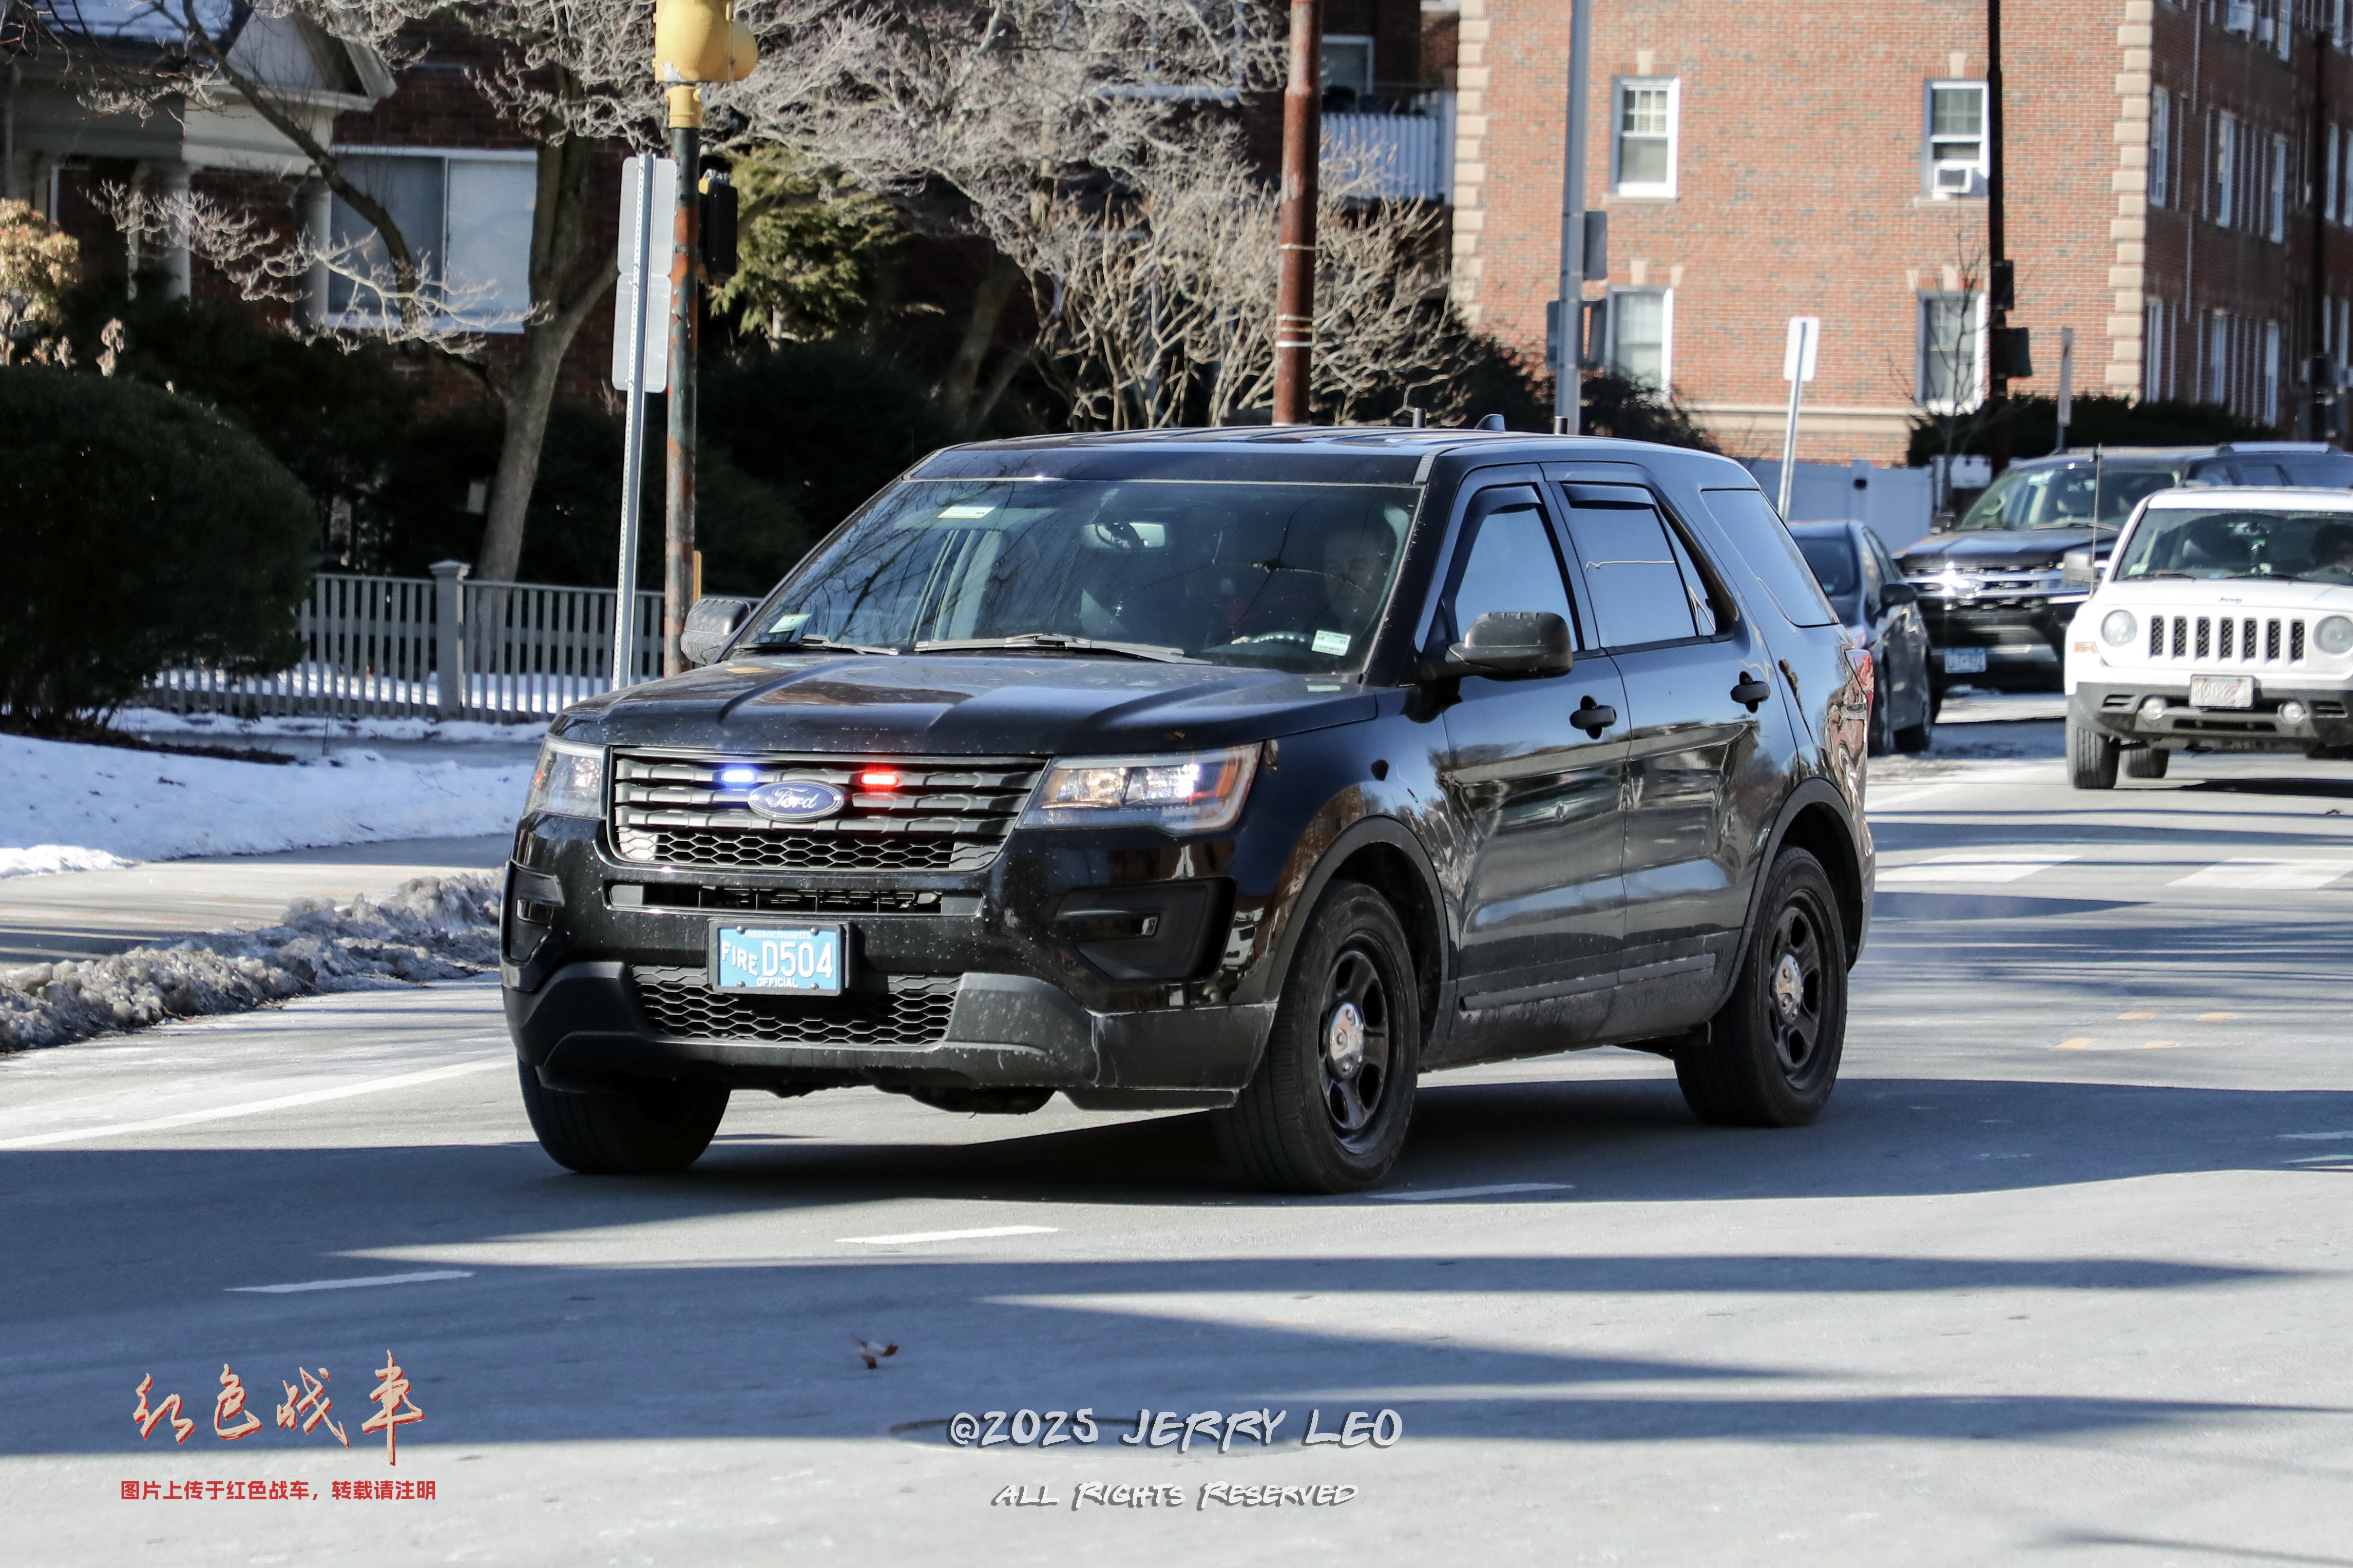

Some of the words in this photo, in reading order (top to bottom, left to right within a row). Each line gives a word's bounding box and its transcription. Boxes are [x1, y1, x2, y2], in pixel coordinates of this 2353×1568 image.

[765, 787, 819, 809] Ford
[721, 940, 759, 976] FIRE
[761, 941, 833, 979] D504
[756, 977, 799, 989] OFFICIAL
